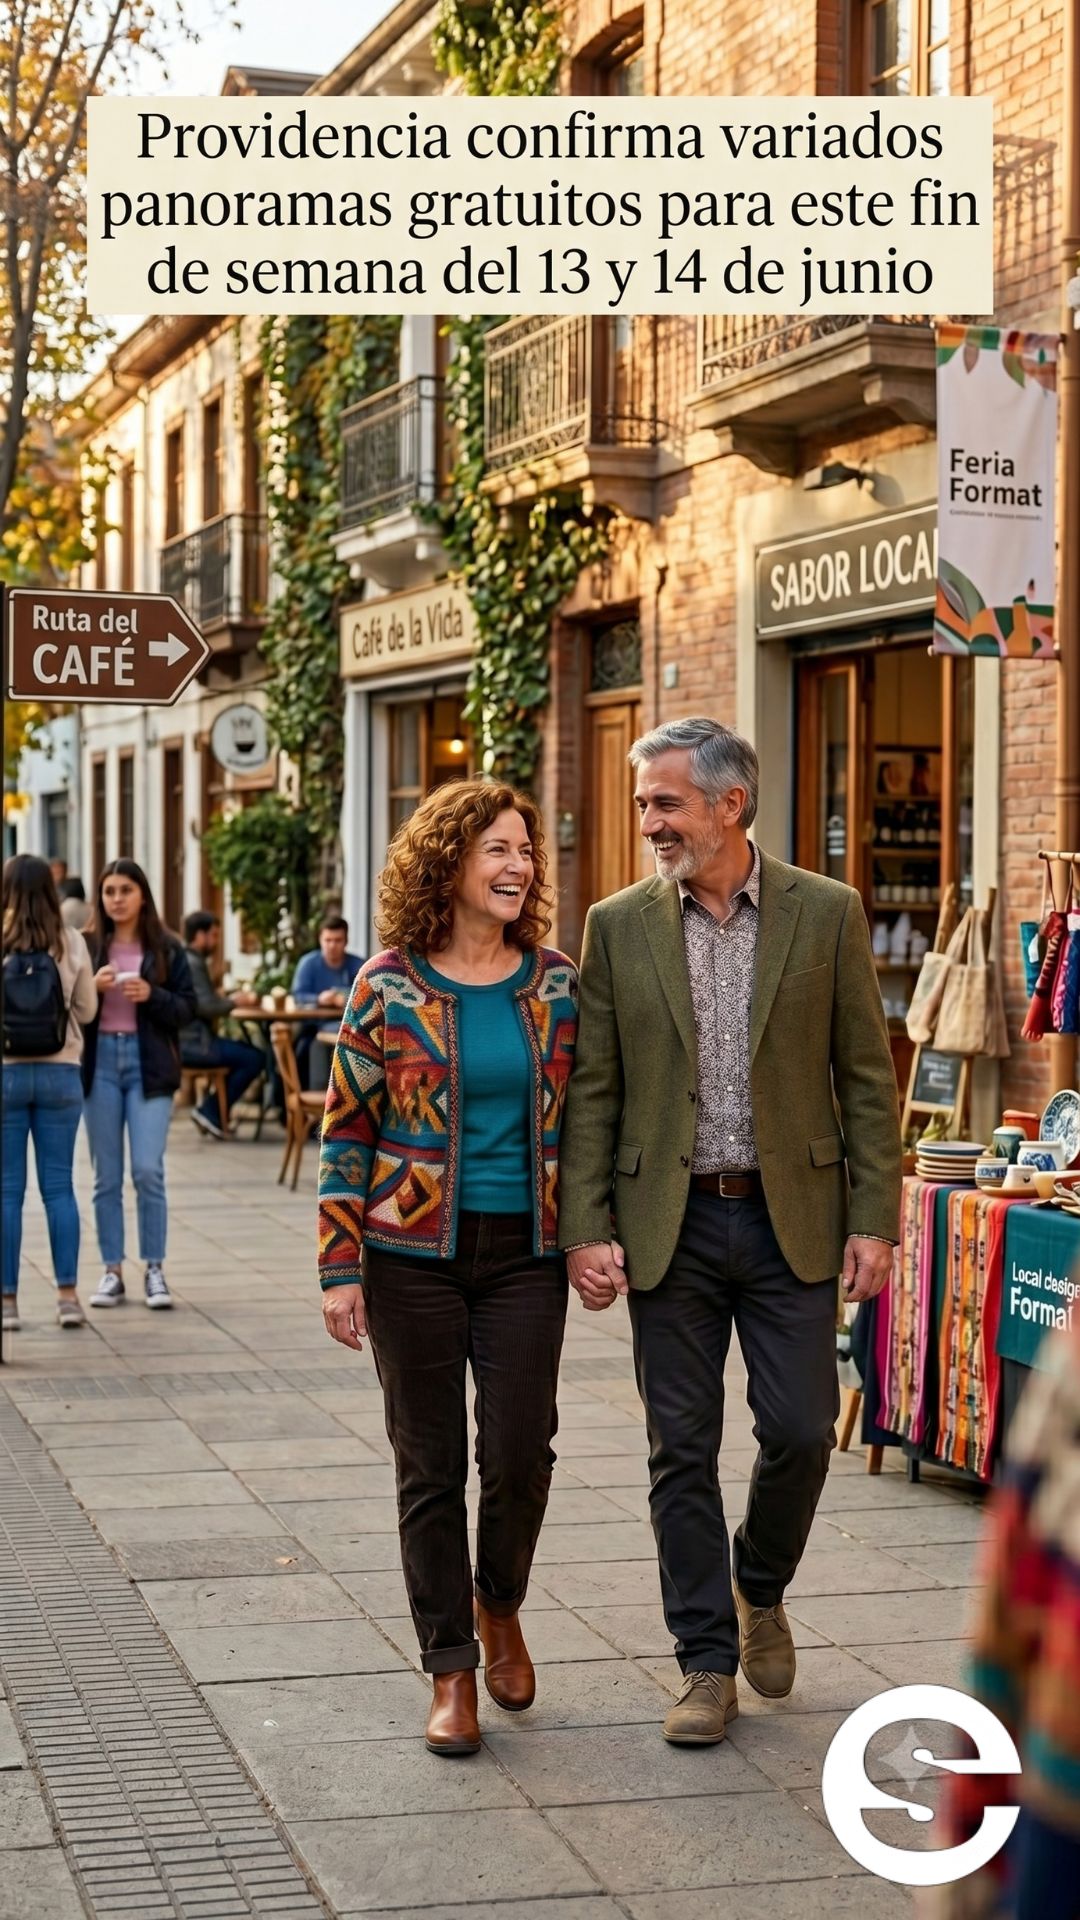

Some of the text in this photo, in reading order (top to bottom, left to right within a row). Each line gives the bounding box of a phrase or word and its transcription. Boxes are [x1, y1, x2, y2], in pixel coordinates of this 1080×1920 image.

[950, 448, 1014, 477] Feria
[950, 477, 1042, 507] Format
[771, 550, 851, 612] SABOR
[33, 604, 139, 634] Ruta del
[352, 616, 383, 659] Café
[387, 612, 405, 652] de
[409, 607, 422, 648] la
[32, 636, 135, 686] CAFÉ
[1012, 1261, 1042, 1289] Local
